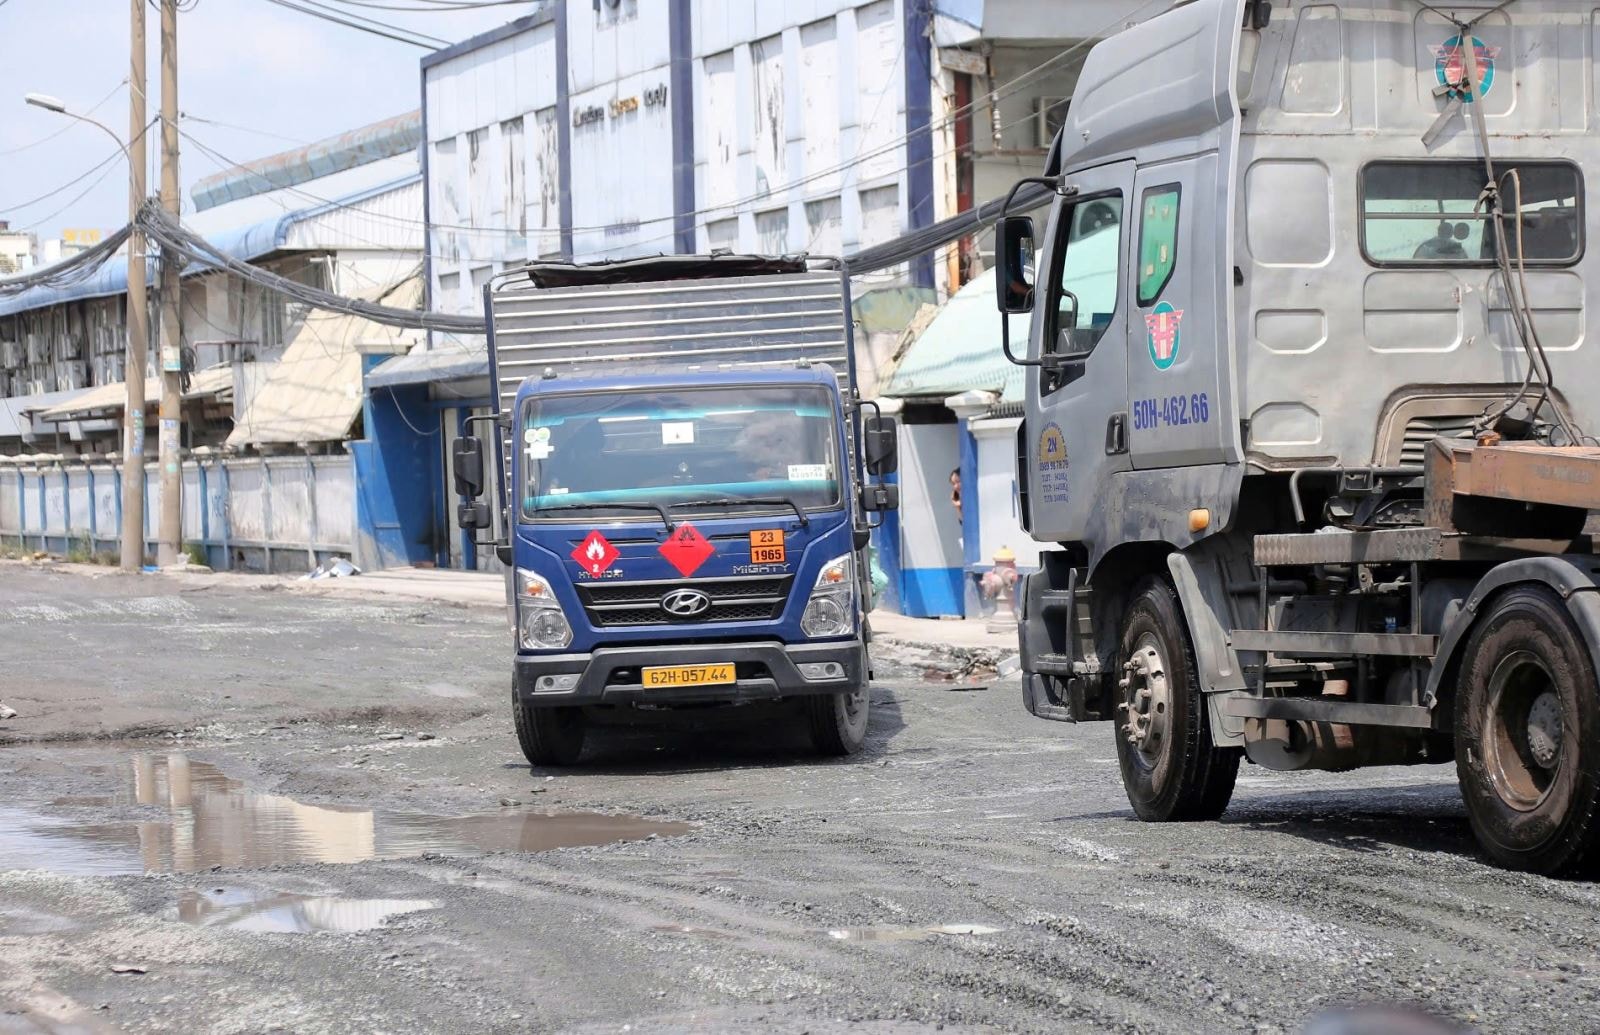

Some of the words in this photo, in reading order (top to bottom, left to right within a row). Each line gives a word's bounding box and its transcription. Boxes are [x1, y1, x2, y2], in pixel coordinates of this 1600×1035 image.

[1133, 392, 1209, 430] 50H-462.66
[1047, 436, 1057, 453] 2N
[759, 531, 774, 543] 23
[754, 549, 782, 561] 1965
[592, 563, 600, 573] 2
[732, 563, 791, 574] MIGHTY
[650, 667, 729, 685] 62H-057.44
